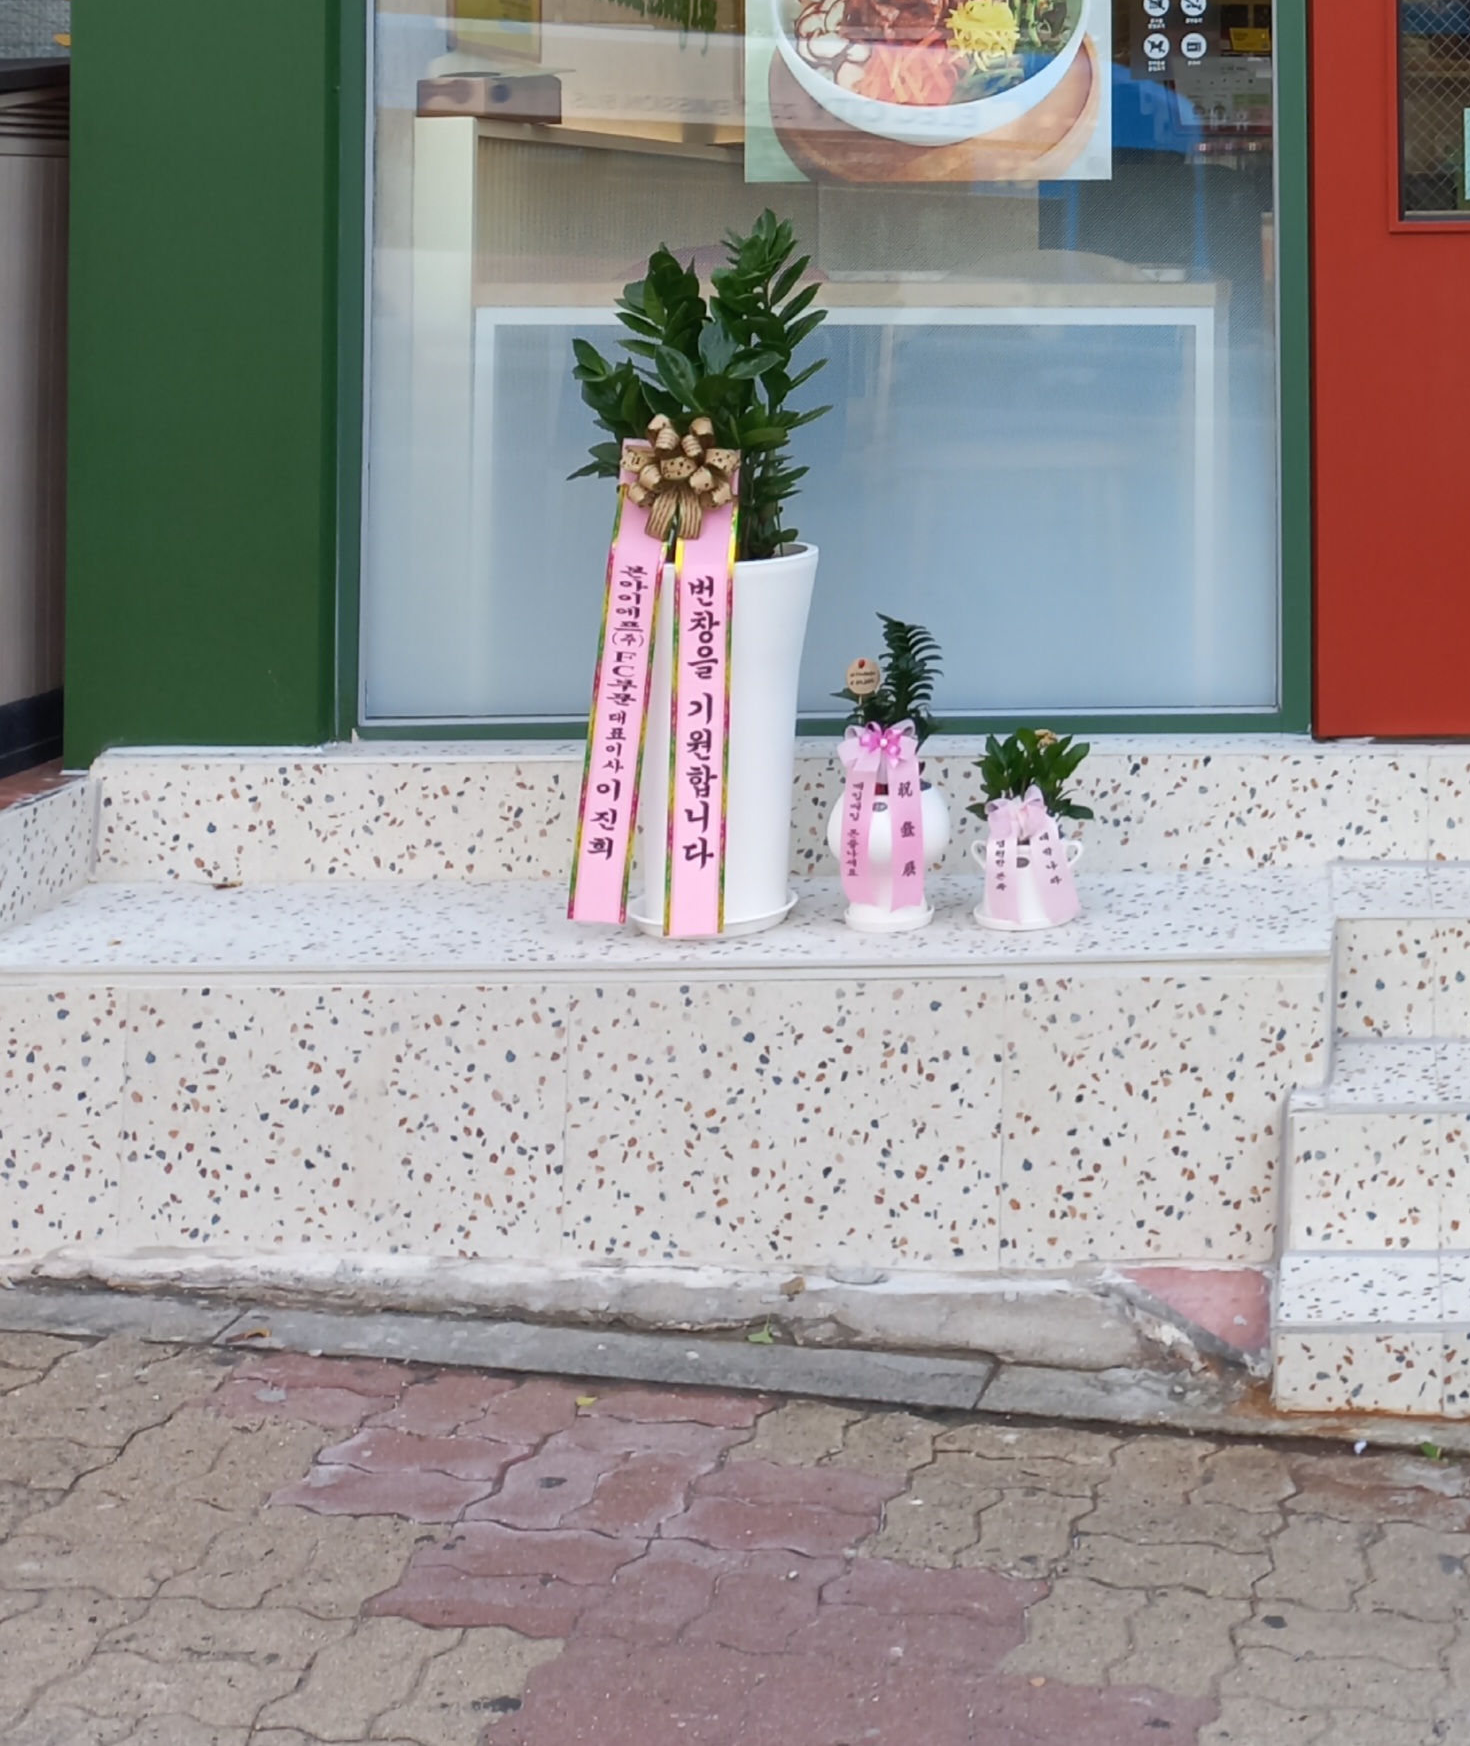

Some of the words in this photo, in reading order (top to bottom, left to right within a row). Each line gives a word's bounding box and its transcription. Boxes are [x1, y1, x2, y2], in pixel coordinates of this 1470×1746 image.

[686, 574, 721, 680] 번창을
[601, 710, 628, 774] 대표이사
[682, 691, 720, 870] 기원합니다
[586, 777, 622, 862] 이진희
